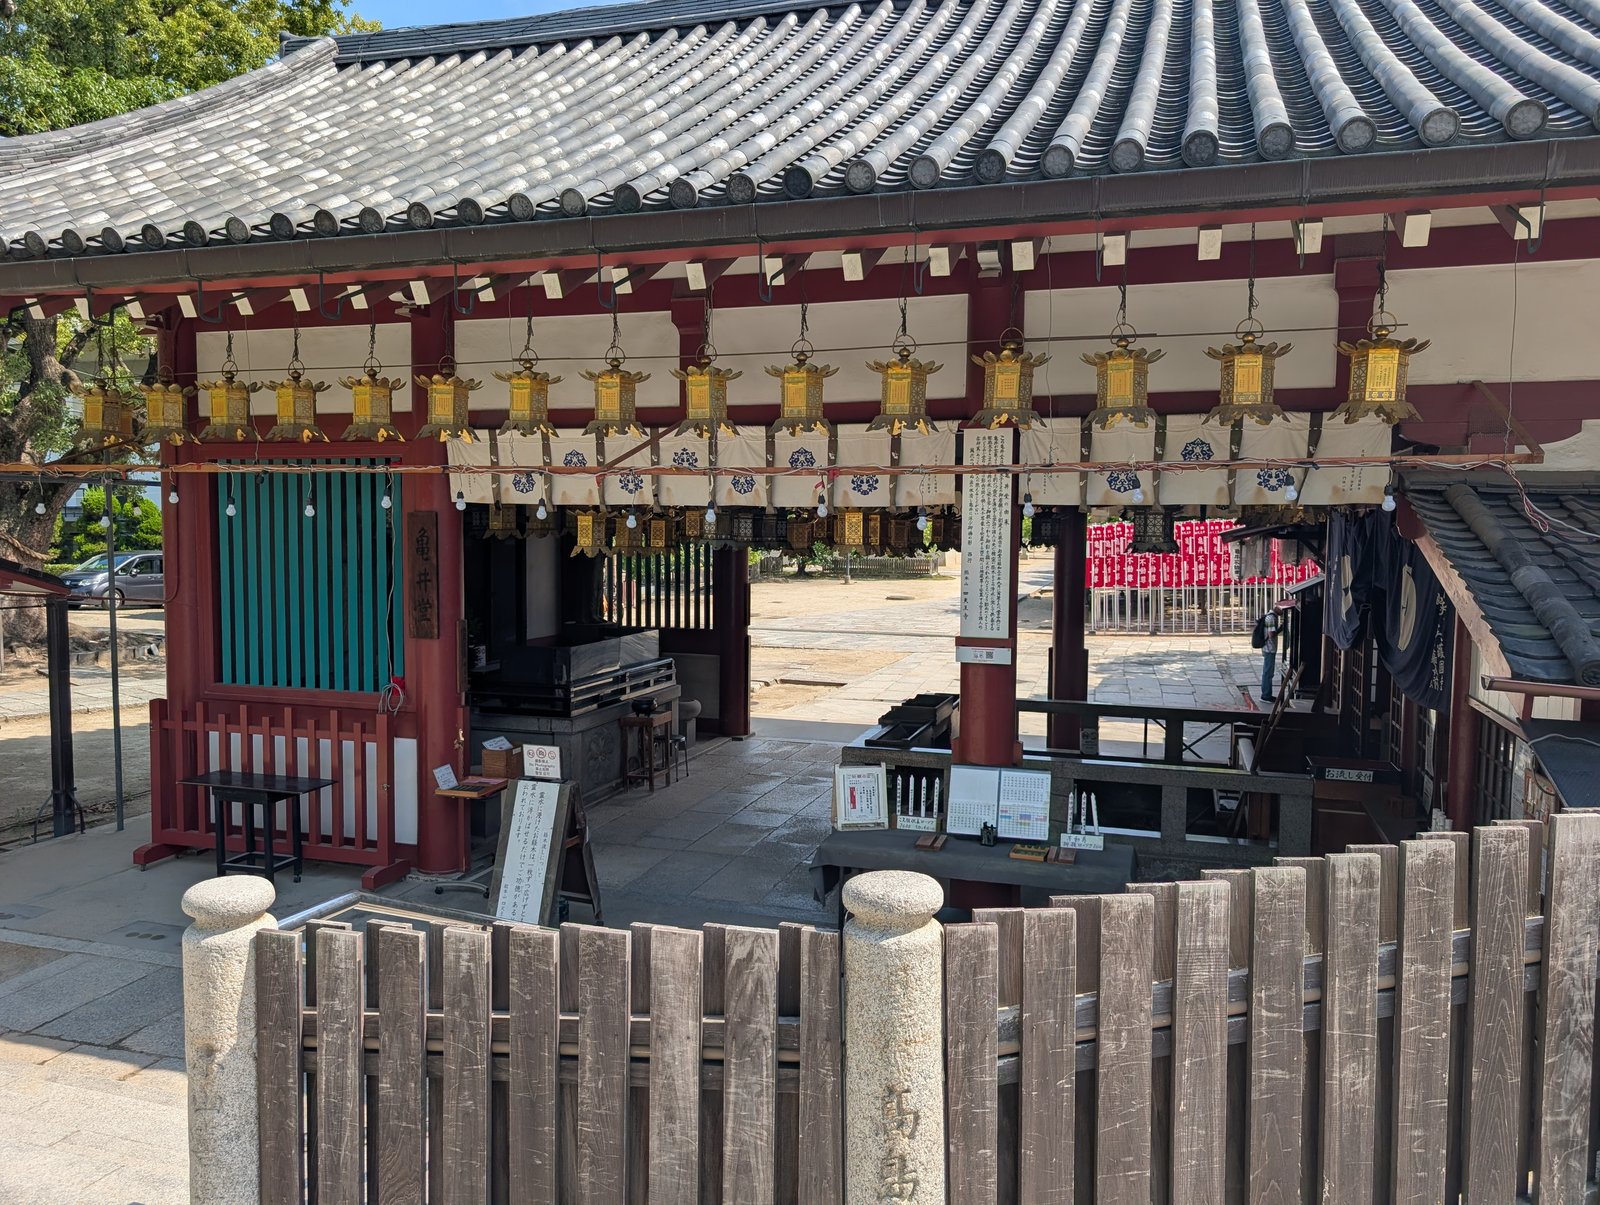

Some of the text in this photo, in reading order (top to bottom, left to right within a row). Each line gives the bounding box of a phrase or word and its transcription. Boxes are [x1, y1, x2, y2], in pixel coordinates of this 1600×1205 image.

[413, 526, 433, 623] 亀井堂
[1197, 536, 1206, 580] 亀井不動尊
[1326, 768, 1372, 782] お流し受付
